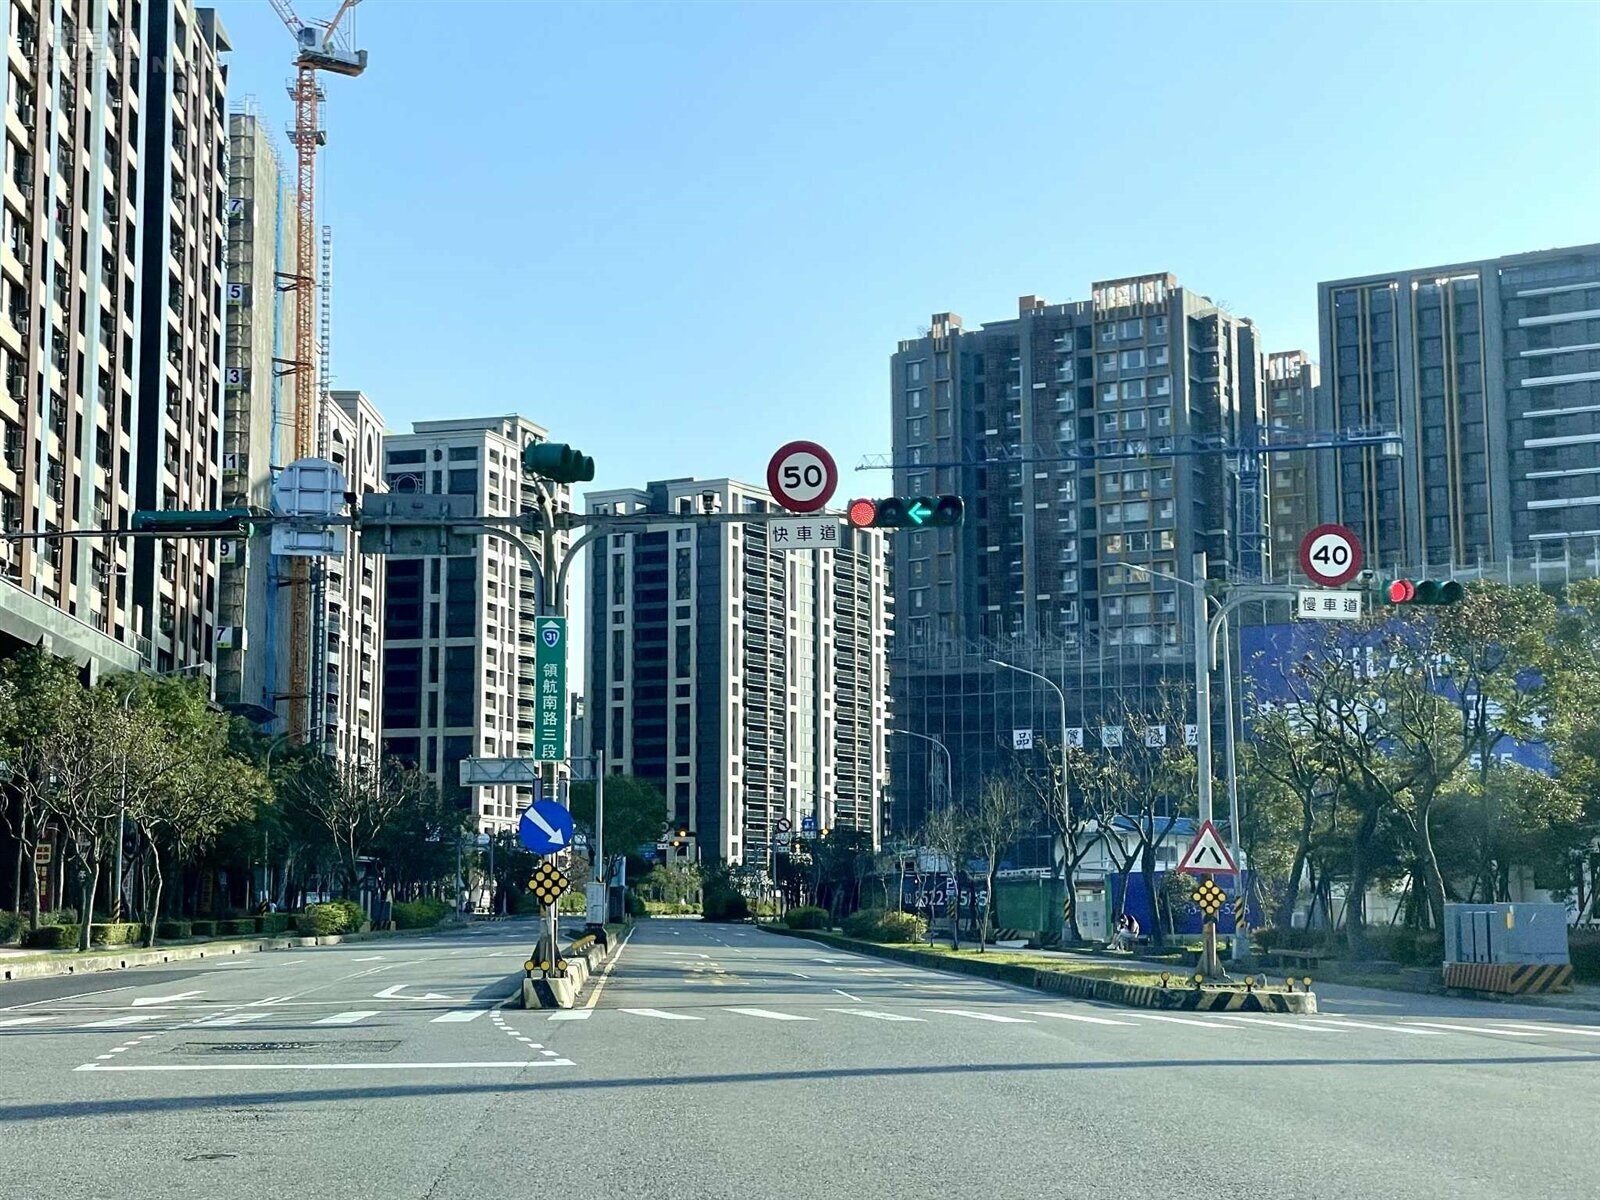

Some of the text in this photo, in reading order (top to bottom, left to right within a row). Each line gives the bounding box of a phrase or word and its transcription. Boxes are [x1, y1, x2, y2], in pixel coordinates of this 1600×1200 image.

[784, 465, 822, 489] 50
[773, 525, 837, 541] 快車道
[1313, 545, 1348, 565] 40
[1302, 597, 1357, 613] 慢車道
[546, 632, 556, 641] 31
[541, 663, 558, 759] 領航南路三段
